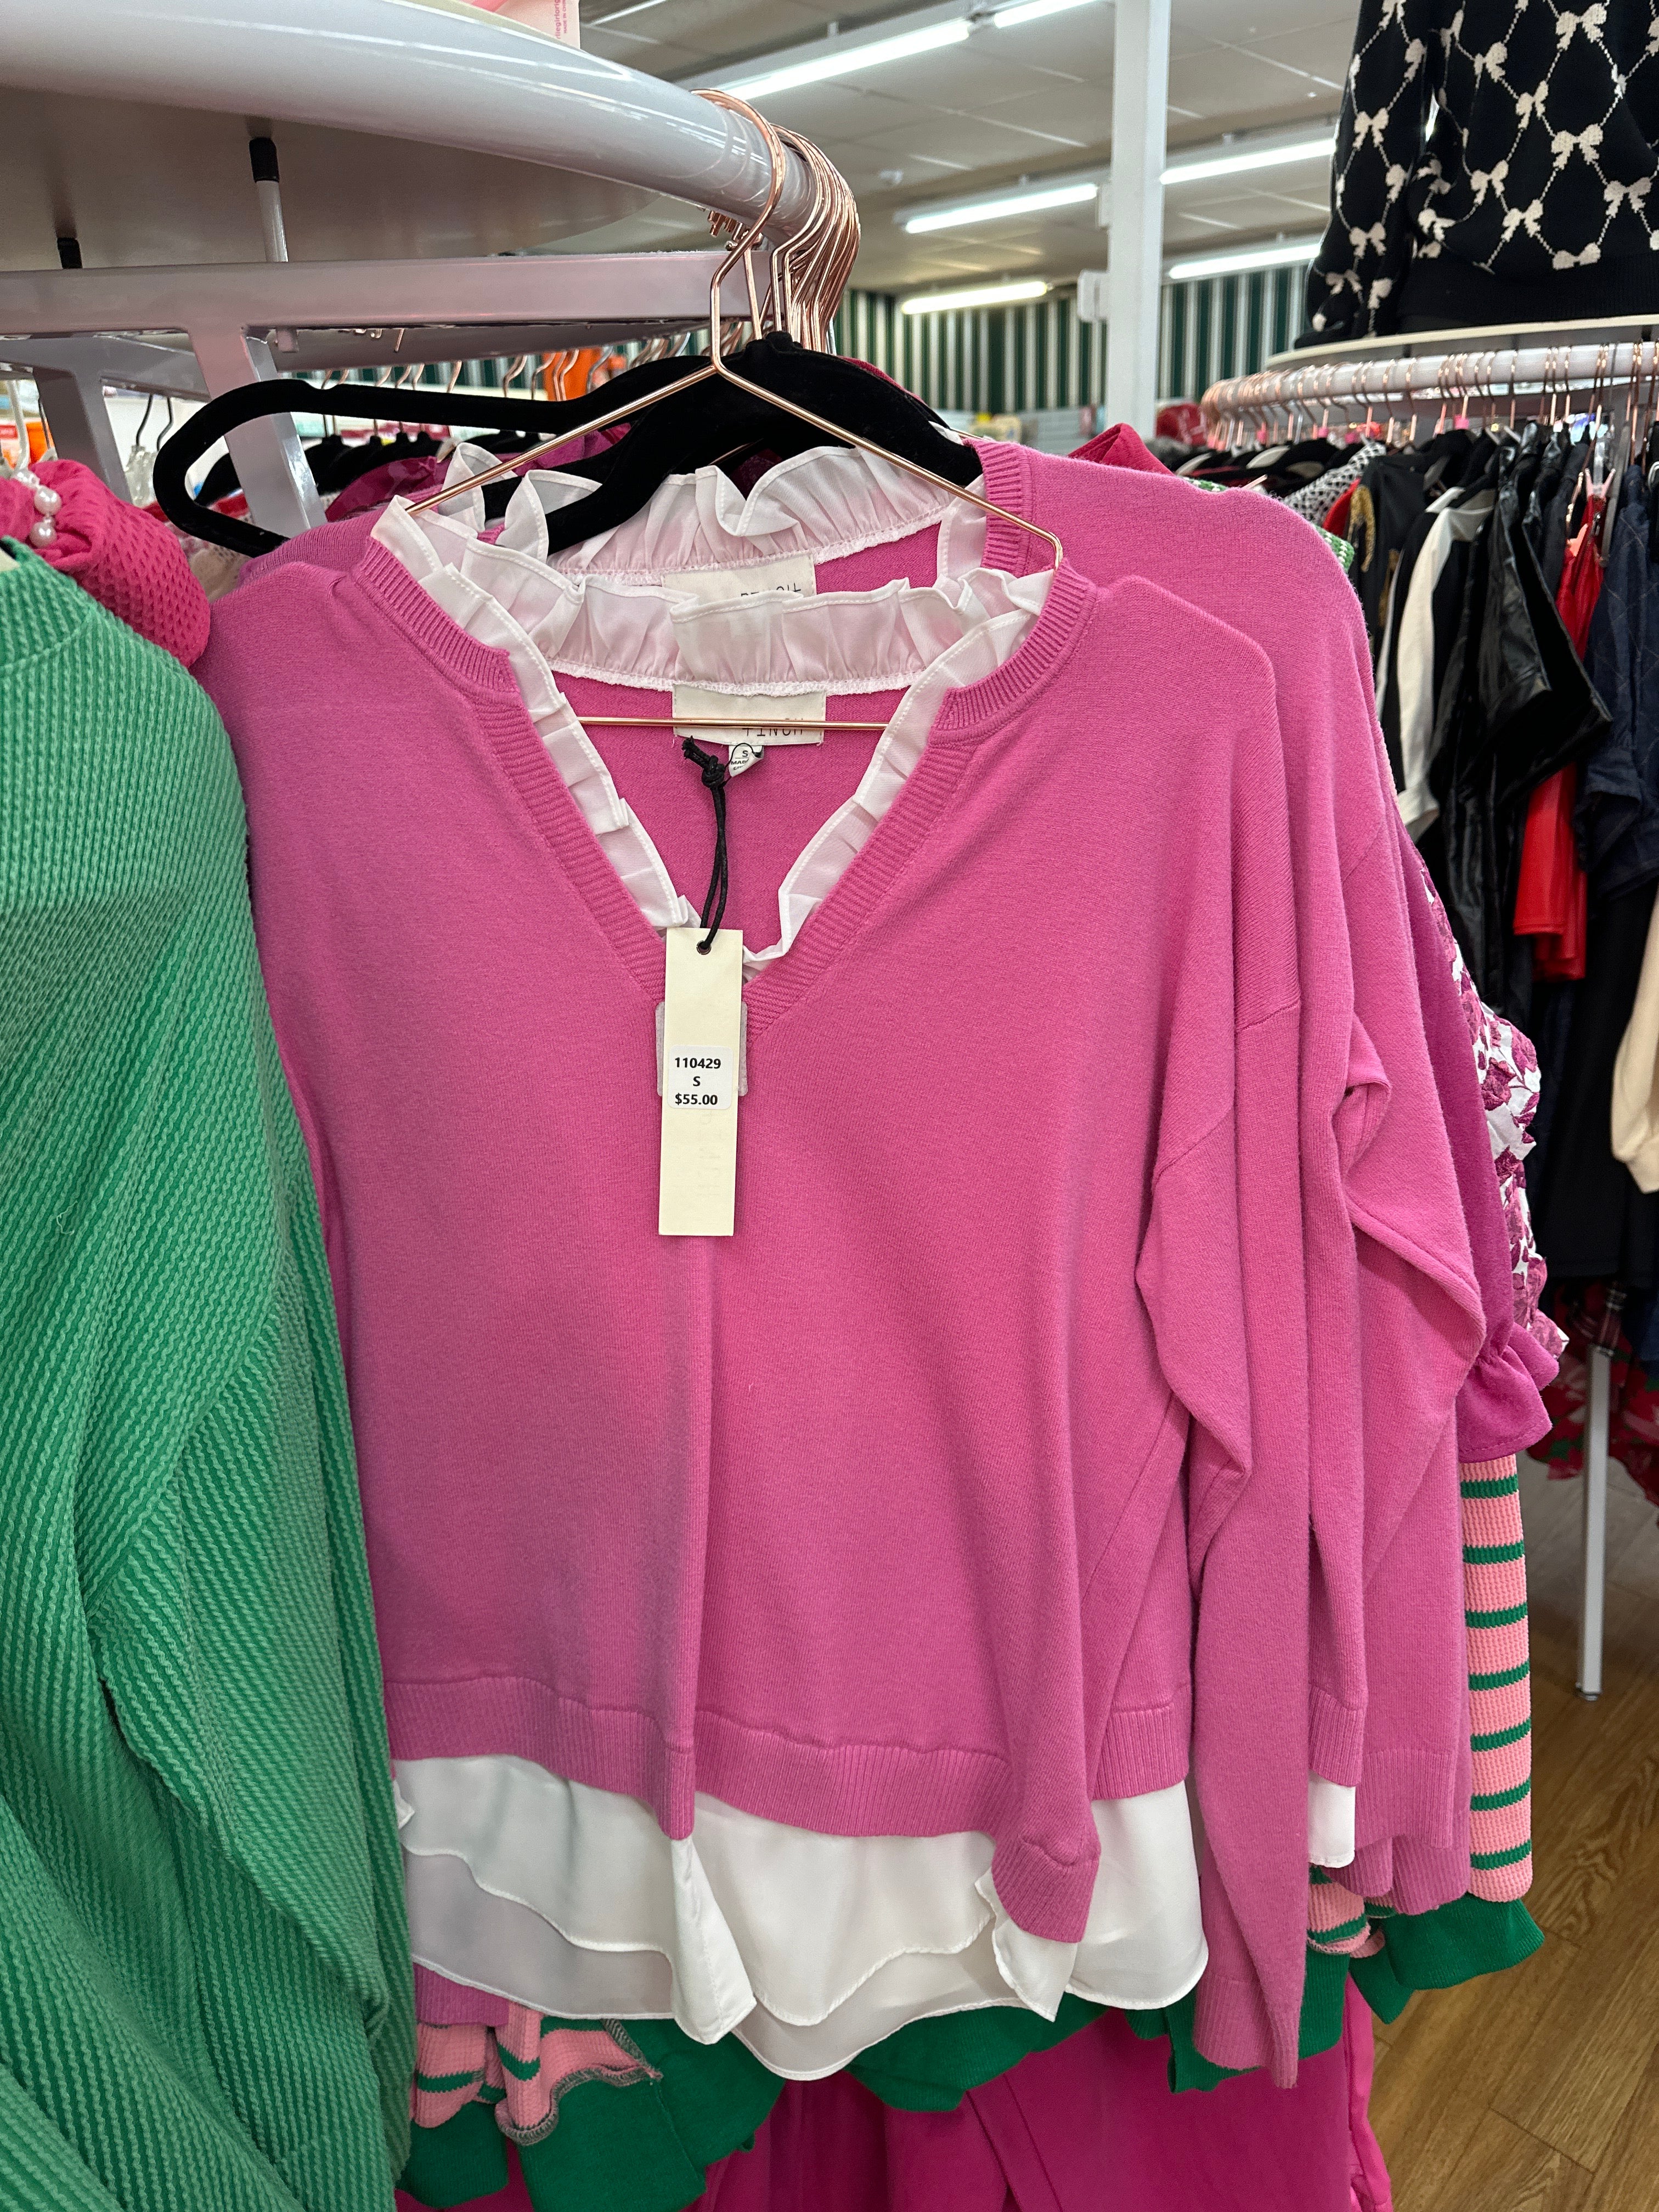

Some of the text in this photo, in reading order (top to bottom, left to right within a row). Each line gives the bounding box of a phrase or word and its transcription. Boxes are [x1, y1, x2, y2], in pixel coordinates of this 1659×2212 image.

[675, 1057, 721, 1069] 110429
[693, 1076, 701, 1087] S
[675, 1092, 718, 1105] $55.00
